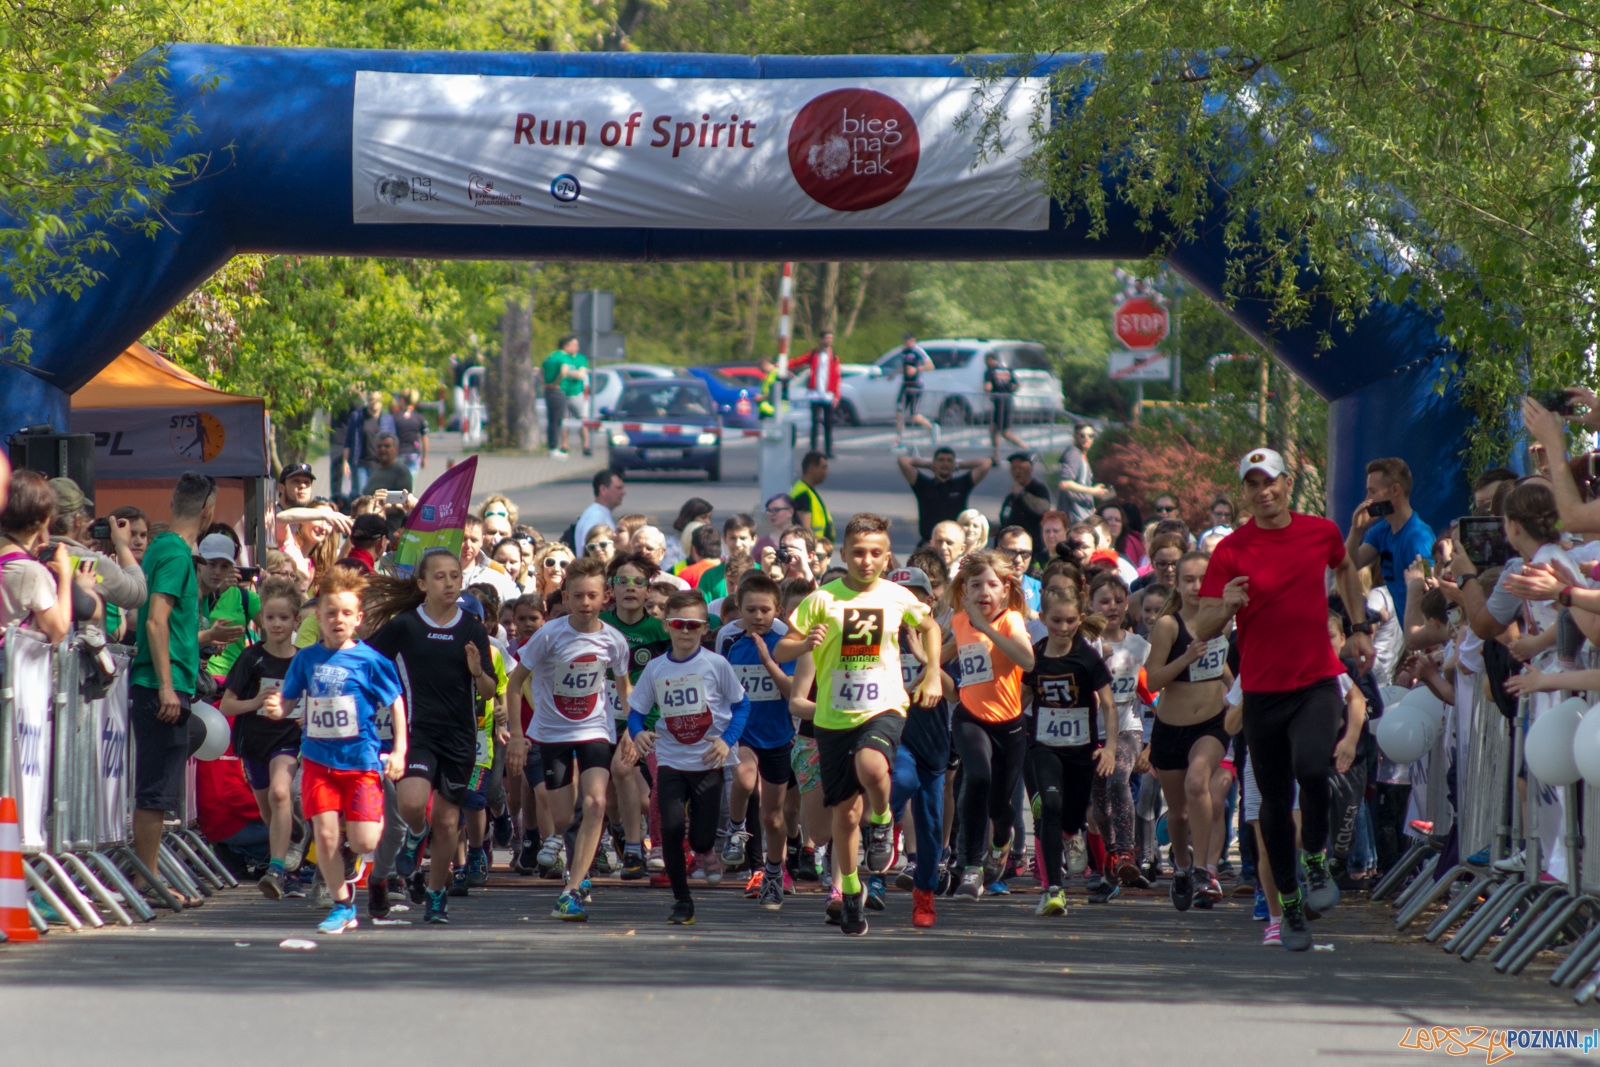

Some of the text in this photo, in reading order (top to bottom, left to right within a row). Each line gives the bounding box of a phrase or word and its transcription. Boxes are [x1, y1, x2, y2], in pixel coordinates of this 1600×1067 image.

[513, 112, 757, 158] Run of Spirit
[842, 108, 902, 145] bieg
[853, 136, 883, 153] na
[853, 155, 893, 175] tak
[411, 177, 432, 188] na
[557, 182, 575, 196] PZU
[411, 189, 440, 201] tak
[1120, 313, 1164, 333] STOP
[169, 415, 196, 429] STS
[427, 632, 454, 641] LEGEA
[1197, 648, 1226, 669] 437
[562, 672, 598, 689] 467
[741, 676, 773, 692] 476
[1111, 677, 1135, 693] 422
[664, 687, 698, 707] 430
[839, 683, 879, 701] 478
[311, 710, 349, 728] 408
[1046, 719, 1080, 737] 401
